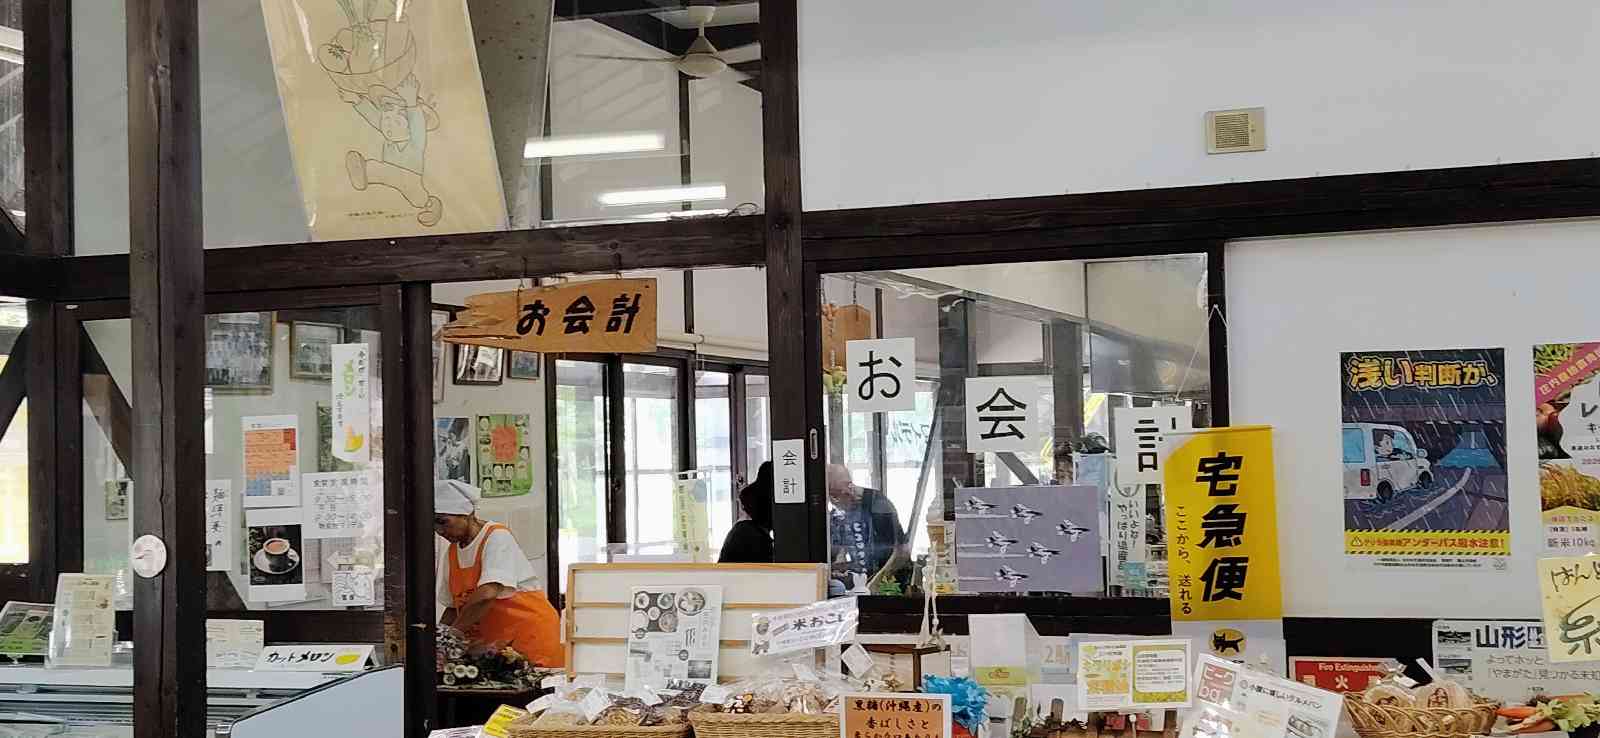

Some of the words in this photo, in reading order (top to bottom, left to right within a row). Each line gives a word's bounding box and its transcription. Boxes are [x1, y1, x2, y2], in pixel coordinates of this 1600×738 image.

[516, 293, 641, 336] お会計
[858, 351, 902, 401] お
[1348, 356, 1498, 391] 浅い判断が、
[976, 387, 1027, 440] 会
[782, 449, 798, 496] 会計
[1195, 451, 1249, 602] 宅急便
[1175, 505, 1193, 615] ここから、送れる
[265, 650, 335, 664] カットメロン
[852, 699, 942, 713] 黒糖(沖縄産)の
[866, 717, 929, 730] 香ばしさと
